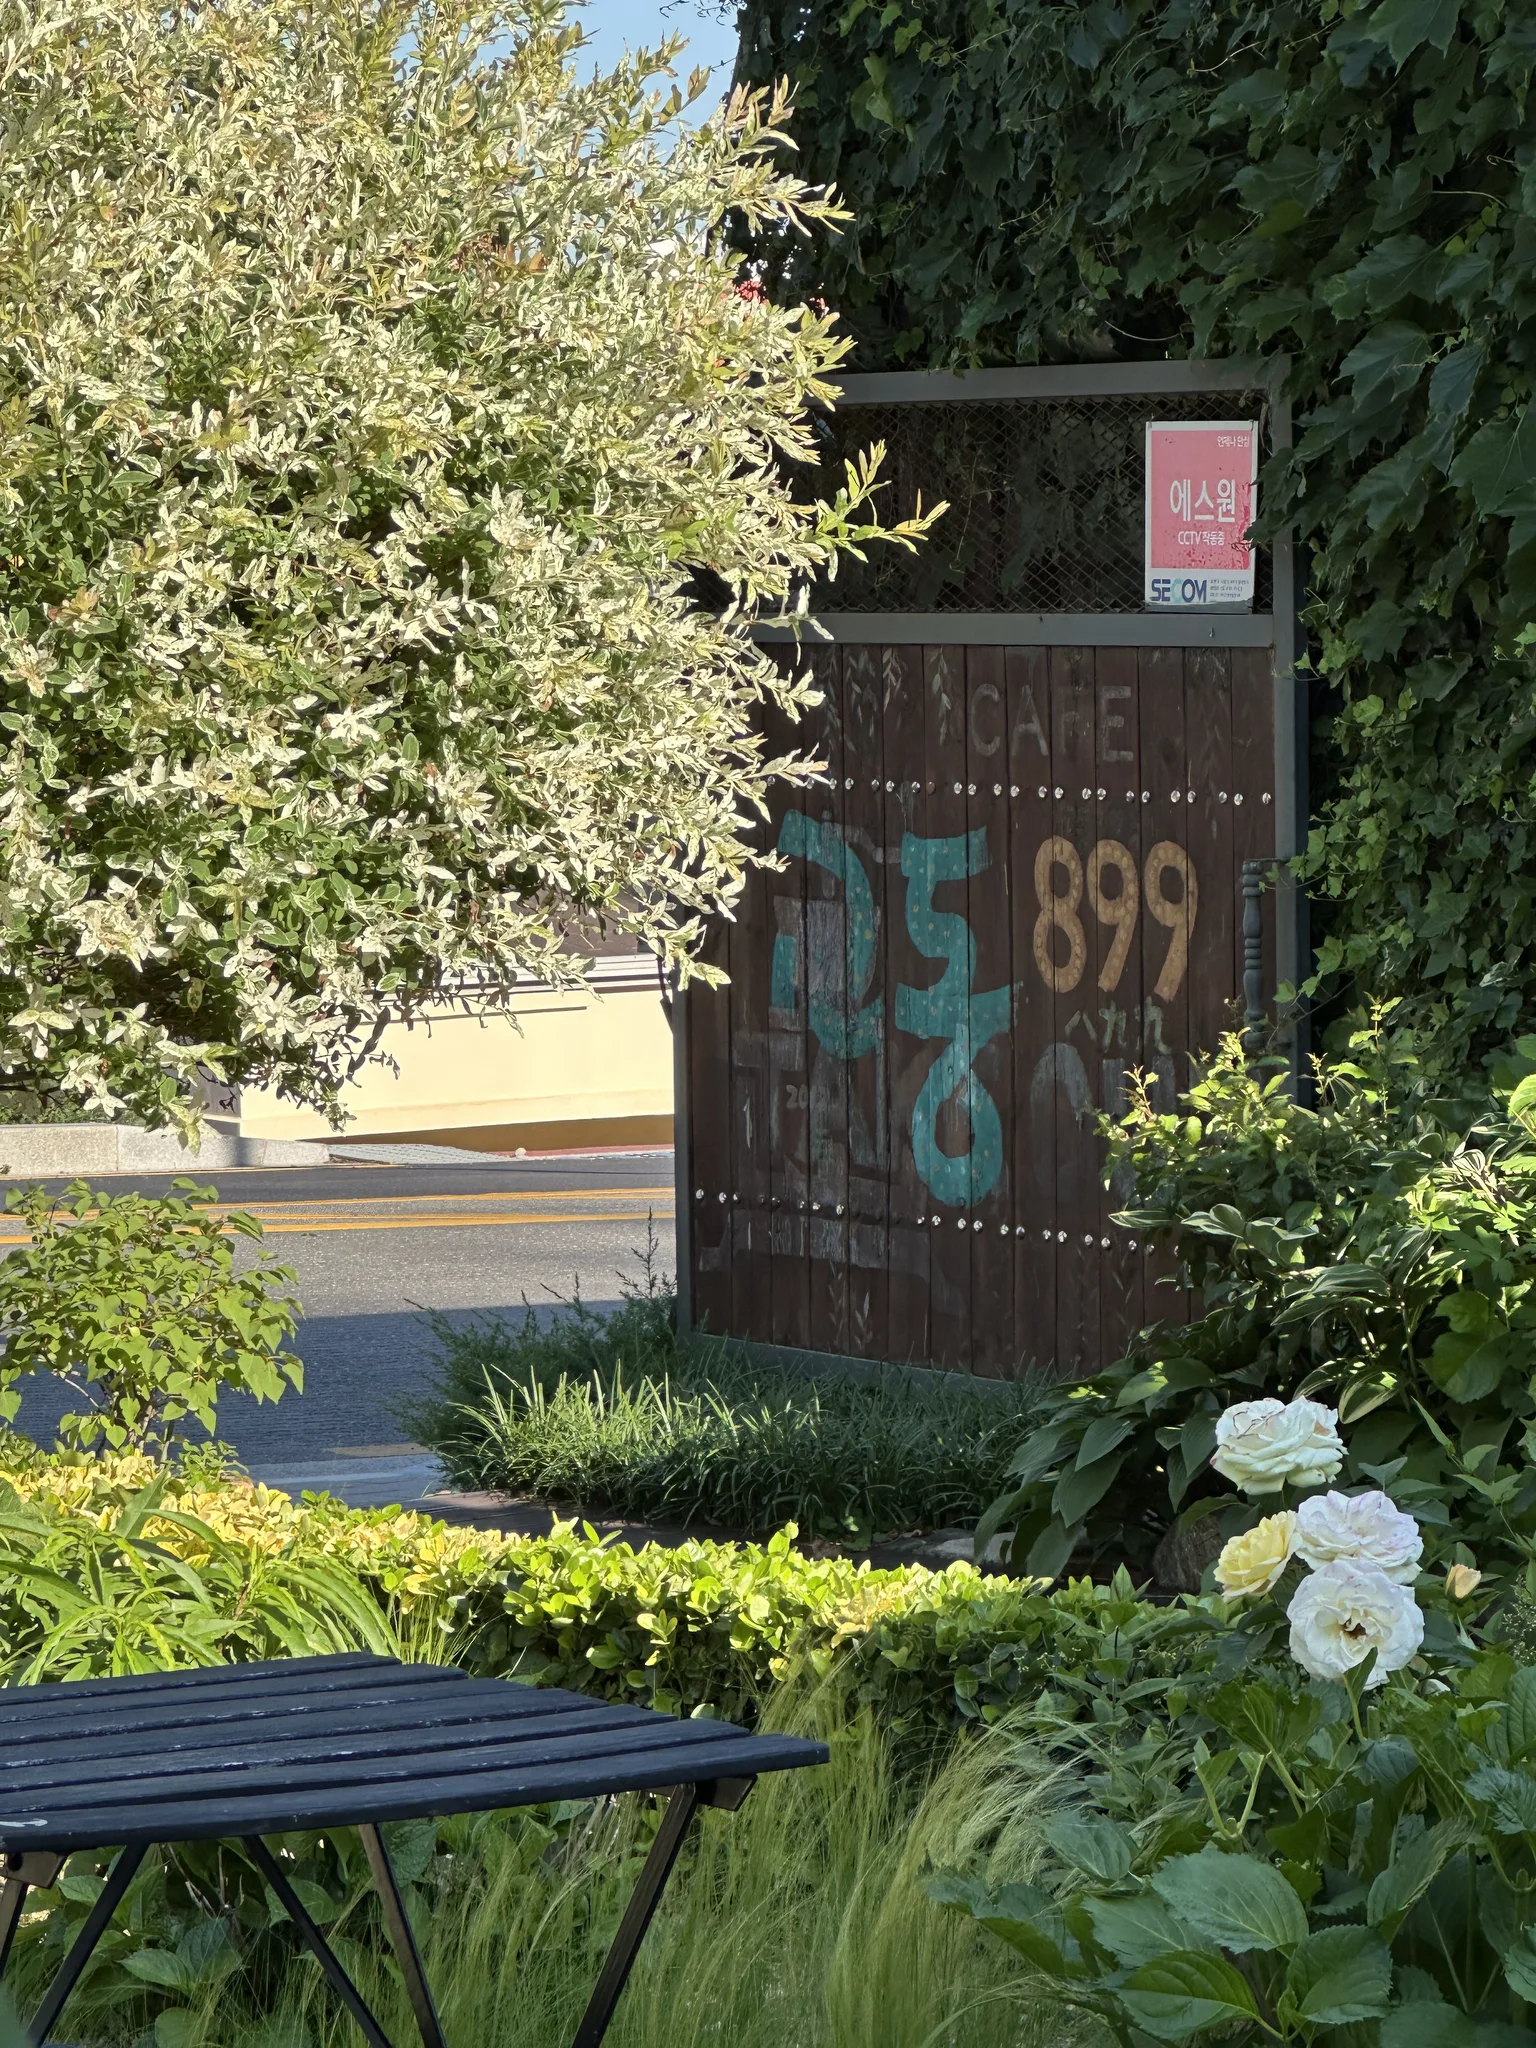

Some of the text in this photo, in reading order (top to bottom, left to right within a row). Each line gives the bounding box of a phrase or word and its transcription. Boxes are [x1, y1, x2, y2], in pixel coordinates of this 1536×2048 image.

[1169, 478, 1236, 523] 에스원
[1177, 530, 1226, 546] CCTV 작동중
[1150, 577, 1207, 603] SECOM
[969, 683, 1135, 763] CAFE
[1033, 834, 1198, 1002] 899
